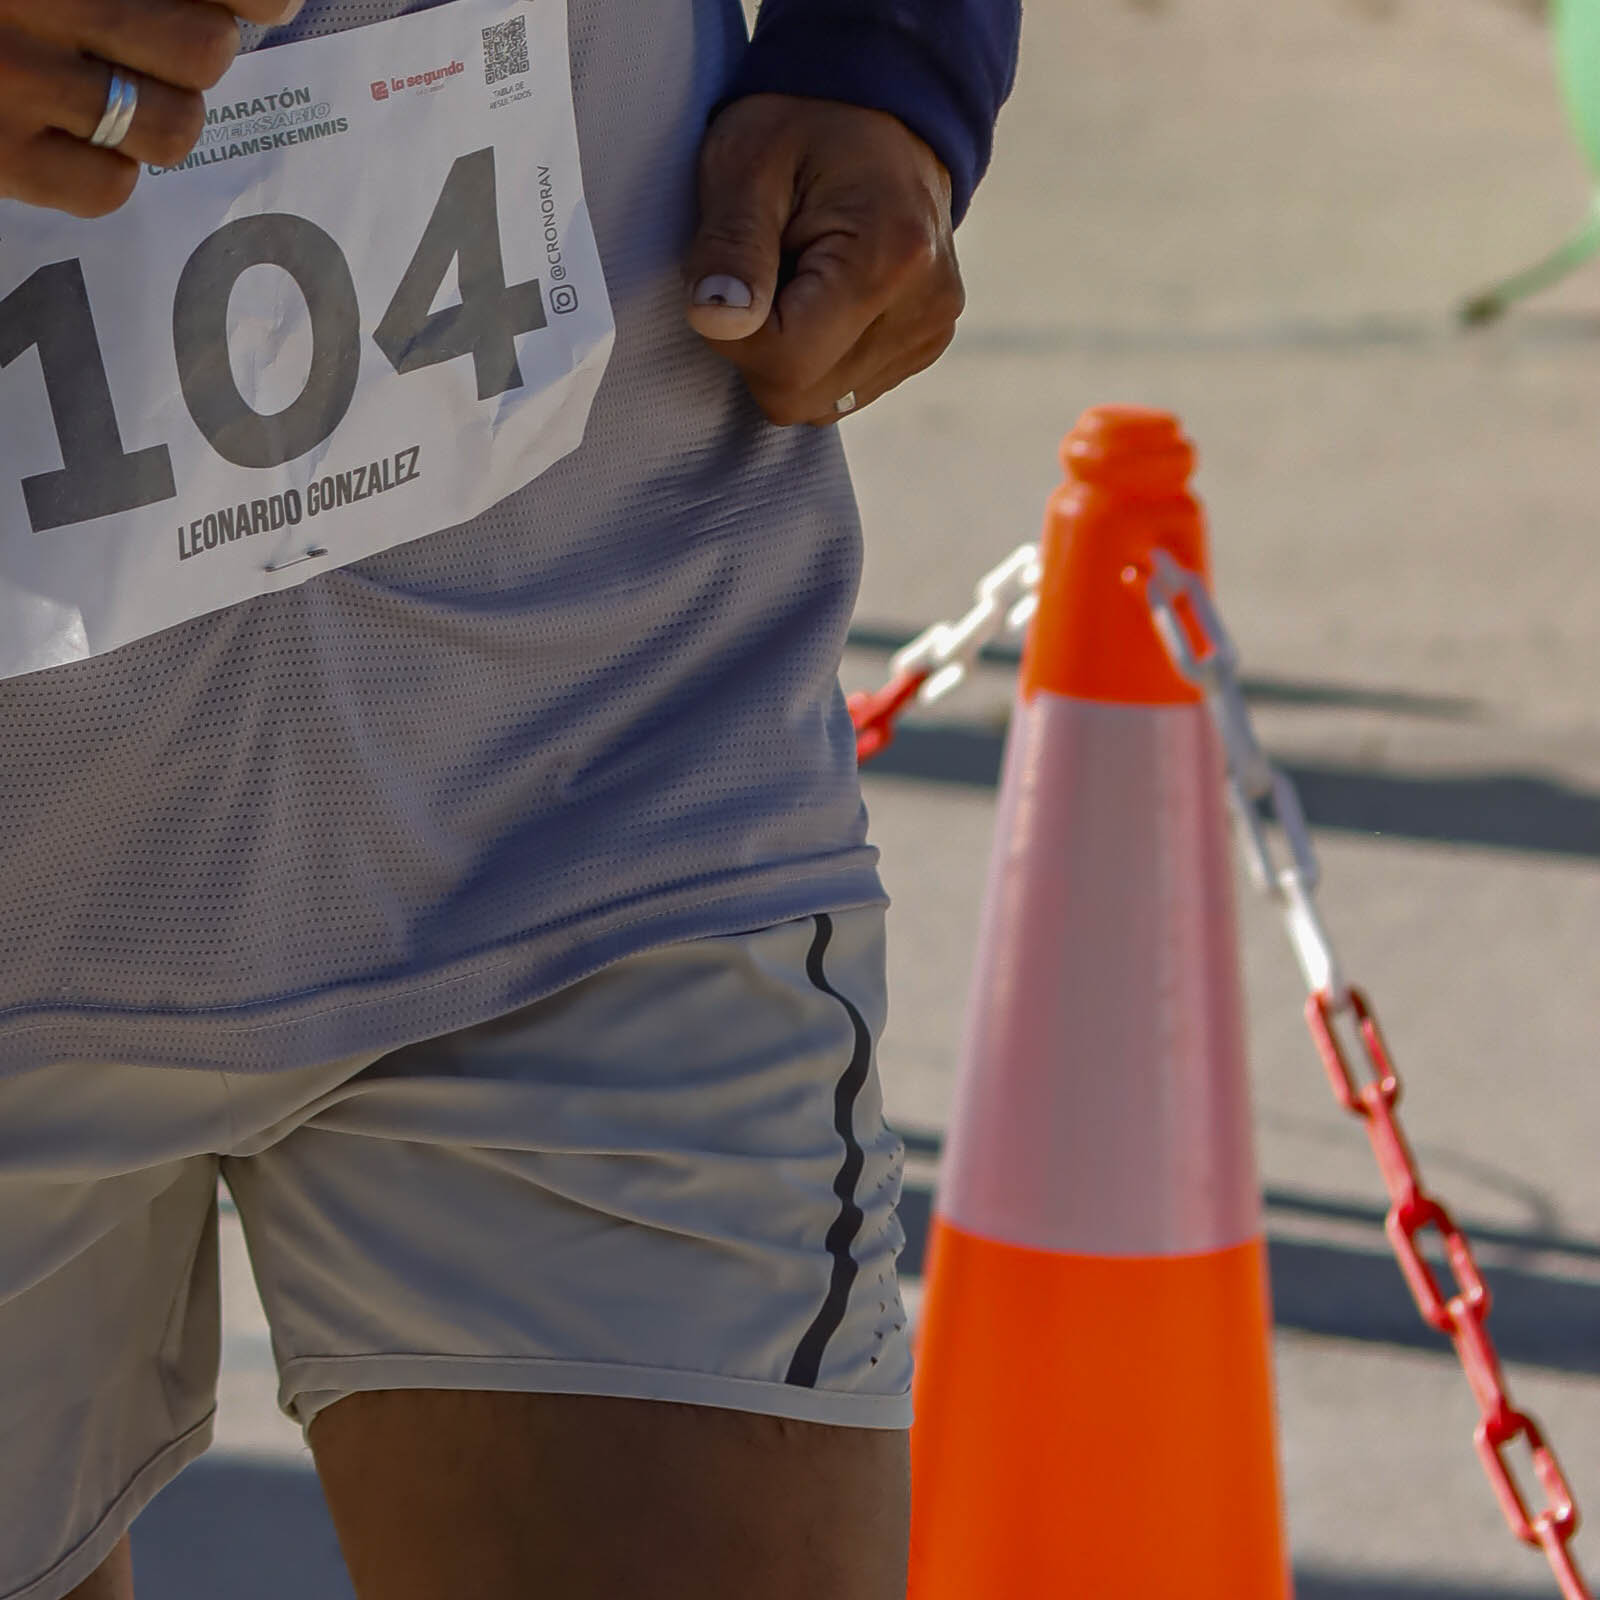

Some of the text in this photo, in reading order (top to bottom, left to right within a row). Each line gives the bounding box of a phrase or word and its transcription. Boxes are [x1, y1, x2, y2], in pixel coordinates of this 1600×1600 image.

[391, 77, 405, 92] la
[406, 60, 465, 87] segunda
[199, 102, 332, 146] IVERSARIO
[205, 87, 311, 126] MARATÓN
[536, 165, 567, 281] @CRONORAV
[177, 445, 421, 561] LEONARDO GONZALEZ
